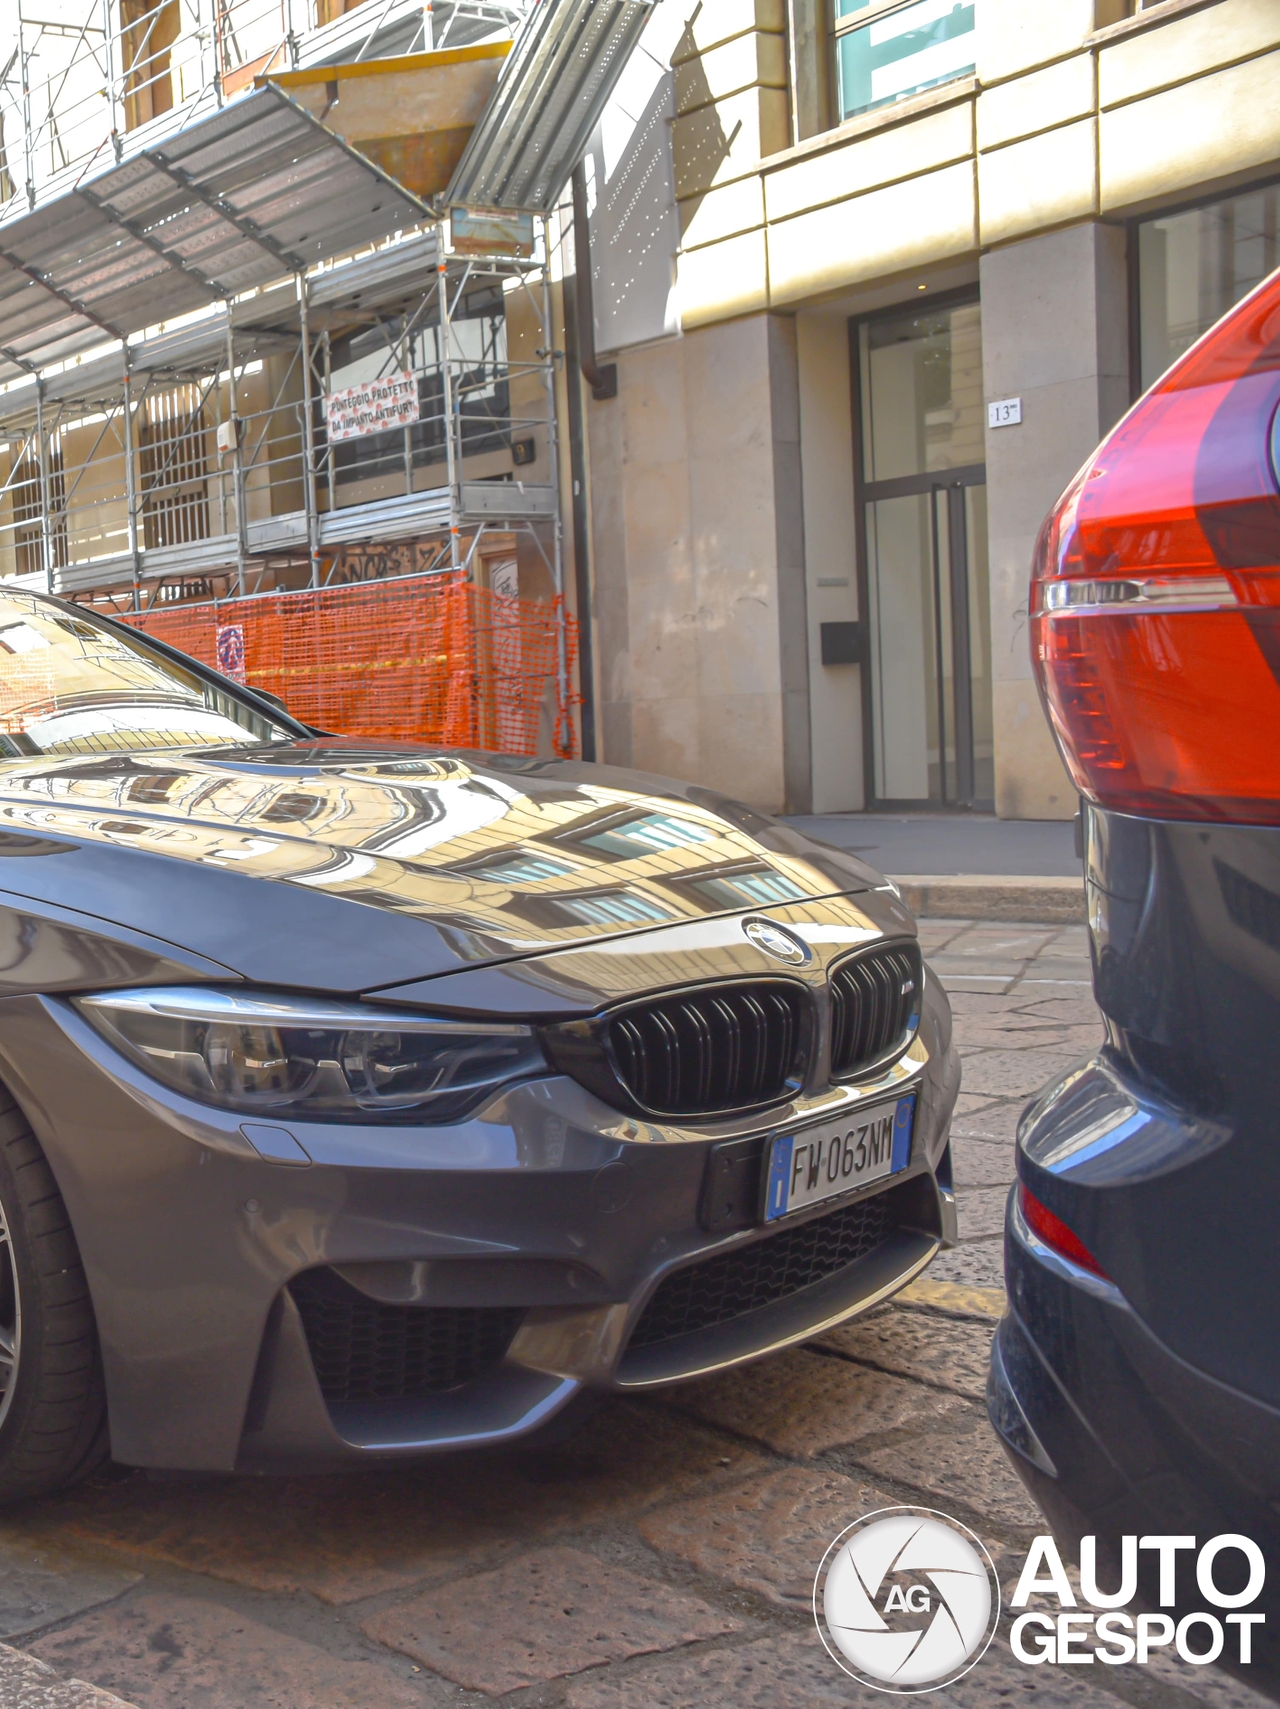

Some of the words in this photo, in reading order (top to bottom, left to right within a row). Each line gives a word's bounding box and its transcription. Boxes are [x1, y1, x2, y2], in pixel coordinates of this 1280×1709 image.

[331, 393, 370, 411] PONTEGGIO
[332, 420, 341, 432] DA
[343, 412, 374, 430] IMPIANTO
[375, 401, 414, 420] ANTIFURT
